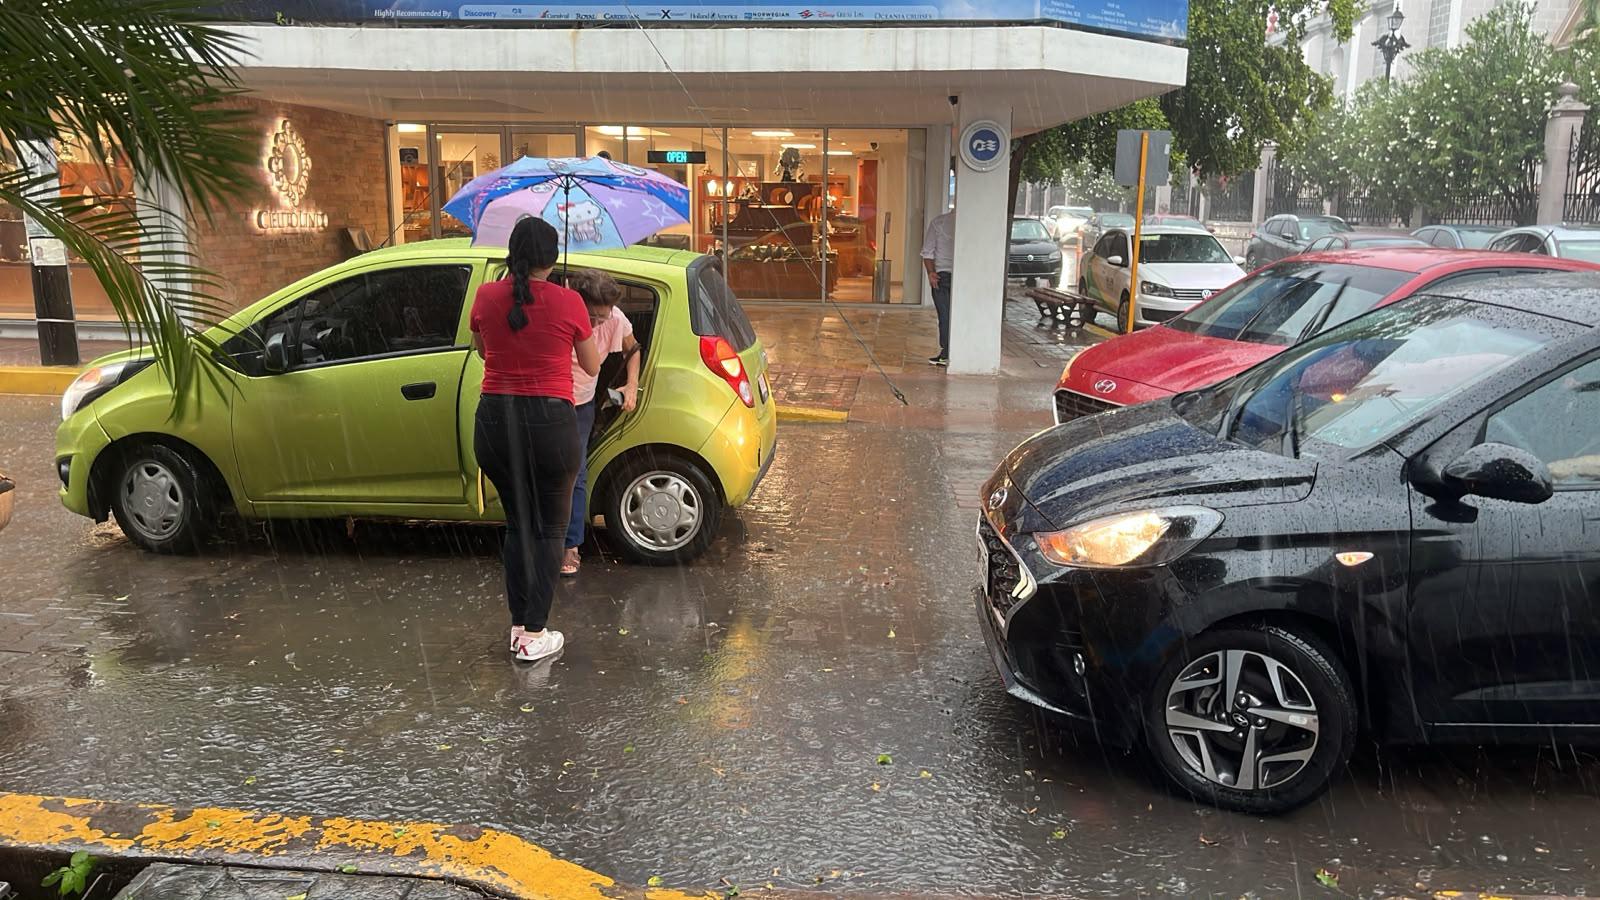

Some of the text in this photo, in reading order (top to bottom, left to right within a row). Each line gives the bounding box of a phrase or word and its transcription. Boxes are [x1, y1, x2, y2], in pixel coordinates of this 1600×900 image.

[374, 9, 395, 18] Highly
[396, 9, 441, 17] Recommended
[464, 10, 497, 18] Discovery
[666, 151, 687, 163] OPEN
